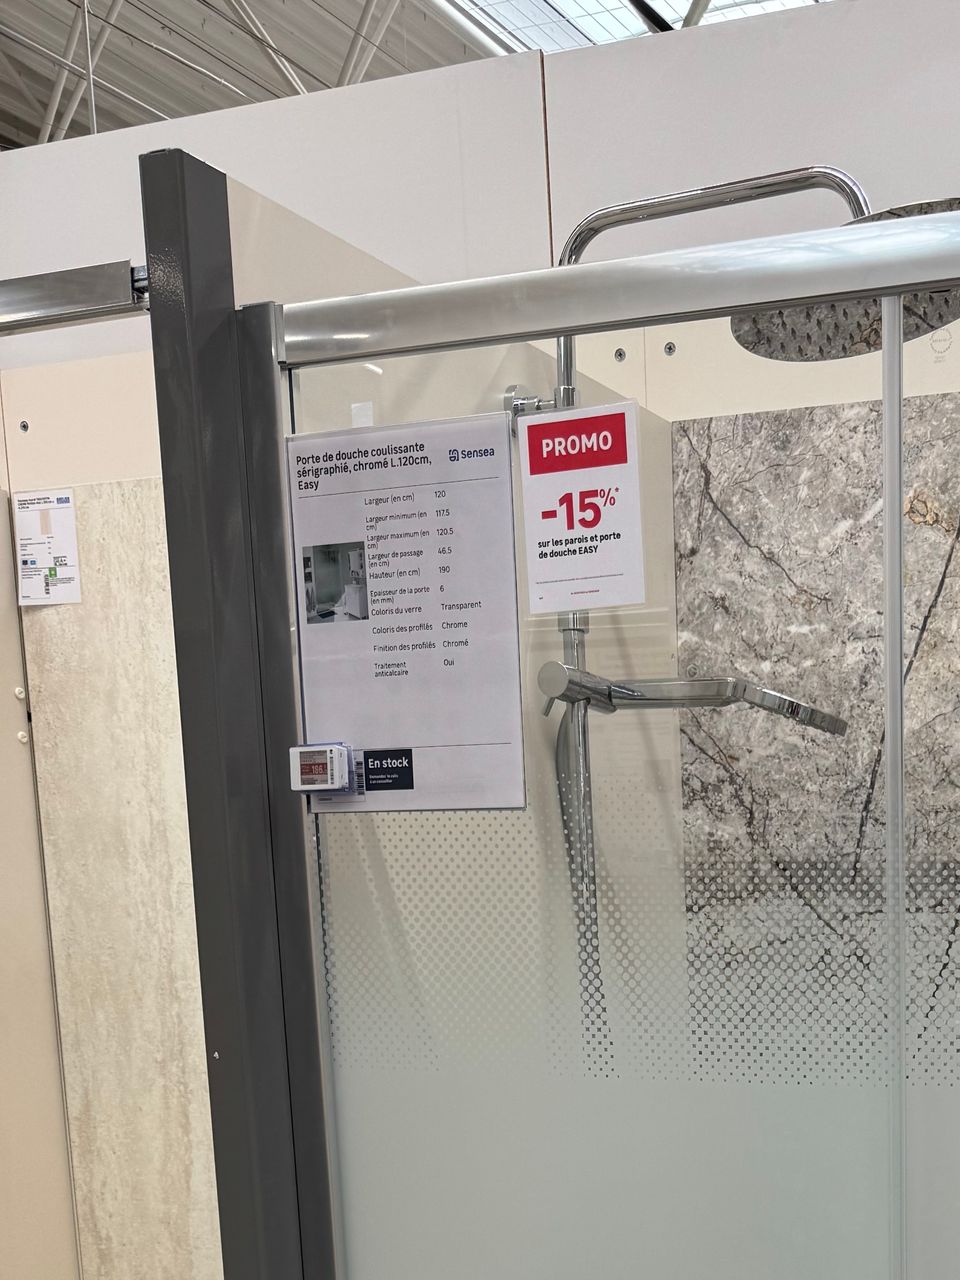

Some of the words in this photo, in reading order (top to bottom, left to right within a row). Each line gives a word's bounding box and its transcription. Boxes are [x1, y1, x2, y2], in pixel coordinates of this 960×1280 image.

[542, 431, 612, 458] PROMO
[296, 453, 321, 465] Porte
[322, 452, 333, 462] de
[335, 447, 369, 461] douche
[370, 442, 425, 457] coulissante
[297, 462, 352, 478] sérigraphié,
[353, 458, 389, 472] chromé
[391, 455, 432, 468] L.120cm,
[298, 480, 319, 491] Easy
[435, 490, 446, 498] 120
[364, 496, 389, 506] Largeur
[391, 494, 401, 504] (en
[402, 493, 414, 502] cm)
[365, 515, 388, 523] Largeur
[389, 511, 416, 520] minimum
[418, 511, 427, 519] (en
[436, 509, 450, 517] 117.5
[391, 531, 419, 539] maximum
[420, 530, 430, 538] (en
[437, 528, 454, 536] 120.5
[538, 540, 550, 548] sur
[565, 535, 588, 547] parois
[590, 534, 598, 542] et
[600, 532, 621, 543] porte
[367, 542, 379, 550] cm)
[438, 546, 452, 555] 46.5
[368, 553, 390, 561] Largeur
[400, 549, 423, 558] passage
[539, 551, 548, 559] de
[549, 548, 577, 558] douche
[579, 545, 598, 555] EASY
[368, 561, 377, 569] (en
[379, 559, 390, 567] cm)
[369, 571, 395, 579] Hauteur
[397, 569, 407, 578] (en
[408, 568, 421, 576] cm)
[439, 566, 450, 574] 190
[370, 589, 398, 597] Epaisseur
[414, 586, 430, 594] porte
[440, 584, 444, 592] 6
[371, 597, 379, 606] (en
[381, 596, 394, 604] mm)
[441, 601, 482, 611] Transparent
[371, 608, 393, 616] Coloris
[405, 606, 422, 614] verre
[372, 626, 395, 634] Coloris
[396, 625, 407, 633] des
[408, 623, 433, 632] profilés
[442, 621, 468, 629] Chrome
[374, 643, 397, 652] Finition
[399, 643, 410, 651] des
[411, 641, 436, 651] profilés
[443, 639, 469, 648] Chromé
[374, 661, 406, 669] Traitement
[374, 670, 408, 678] anticalcaire
[368, 758, 380, 768] En
[382, 757, 409, 768] stock
